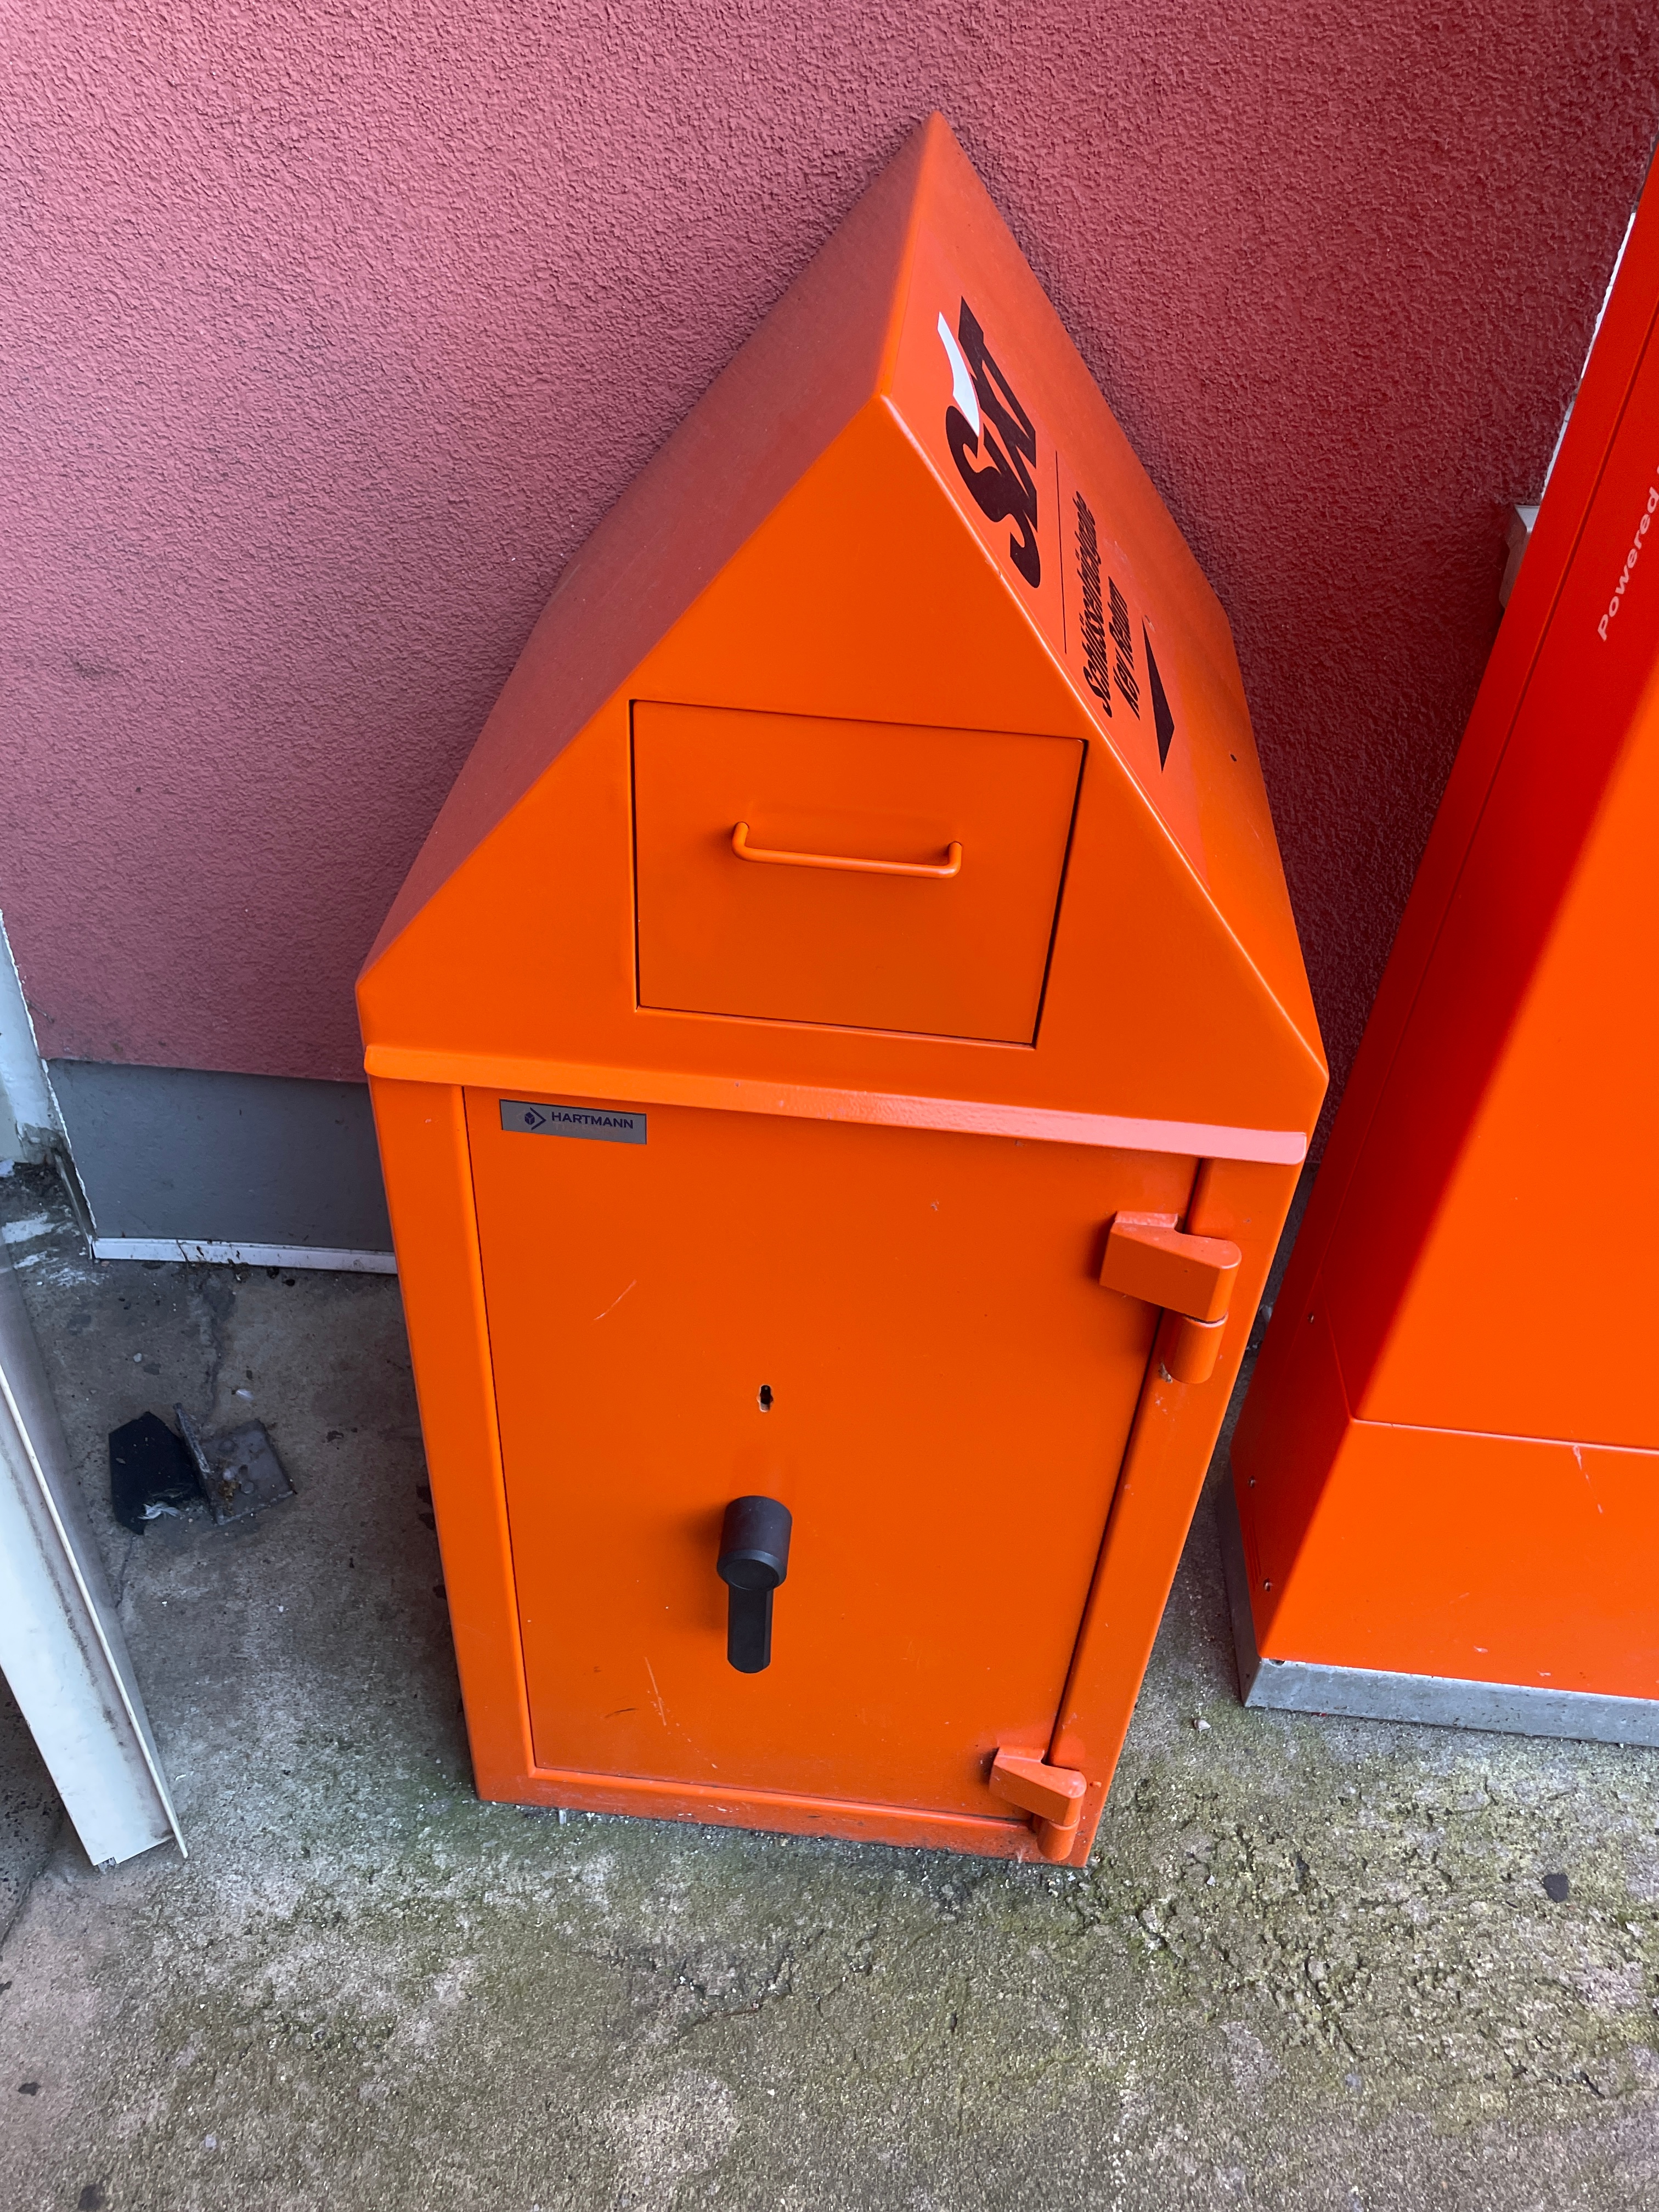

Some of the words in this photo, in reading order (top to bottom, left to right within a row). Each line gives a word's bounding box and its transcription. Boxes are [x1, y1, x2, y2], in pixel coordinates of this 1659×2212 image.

[1072, 490, 1113, 718] Schlüsselrückgabe
[1597, 486, 1659, 641] Powered
[1108, 576, 1134, 670] Return
[1113, 647, 1140, 720] Key
[551, 1111, 634, 1129] HARTMANN
